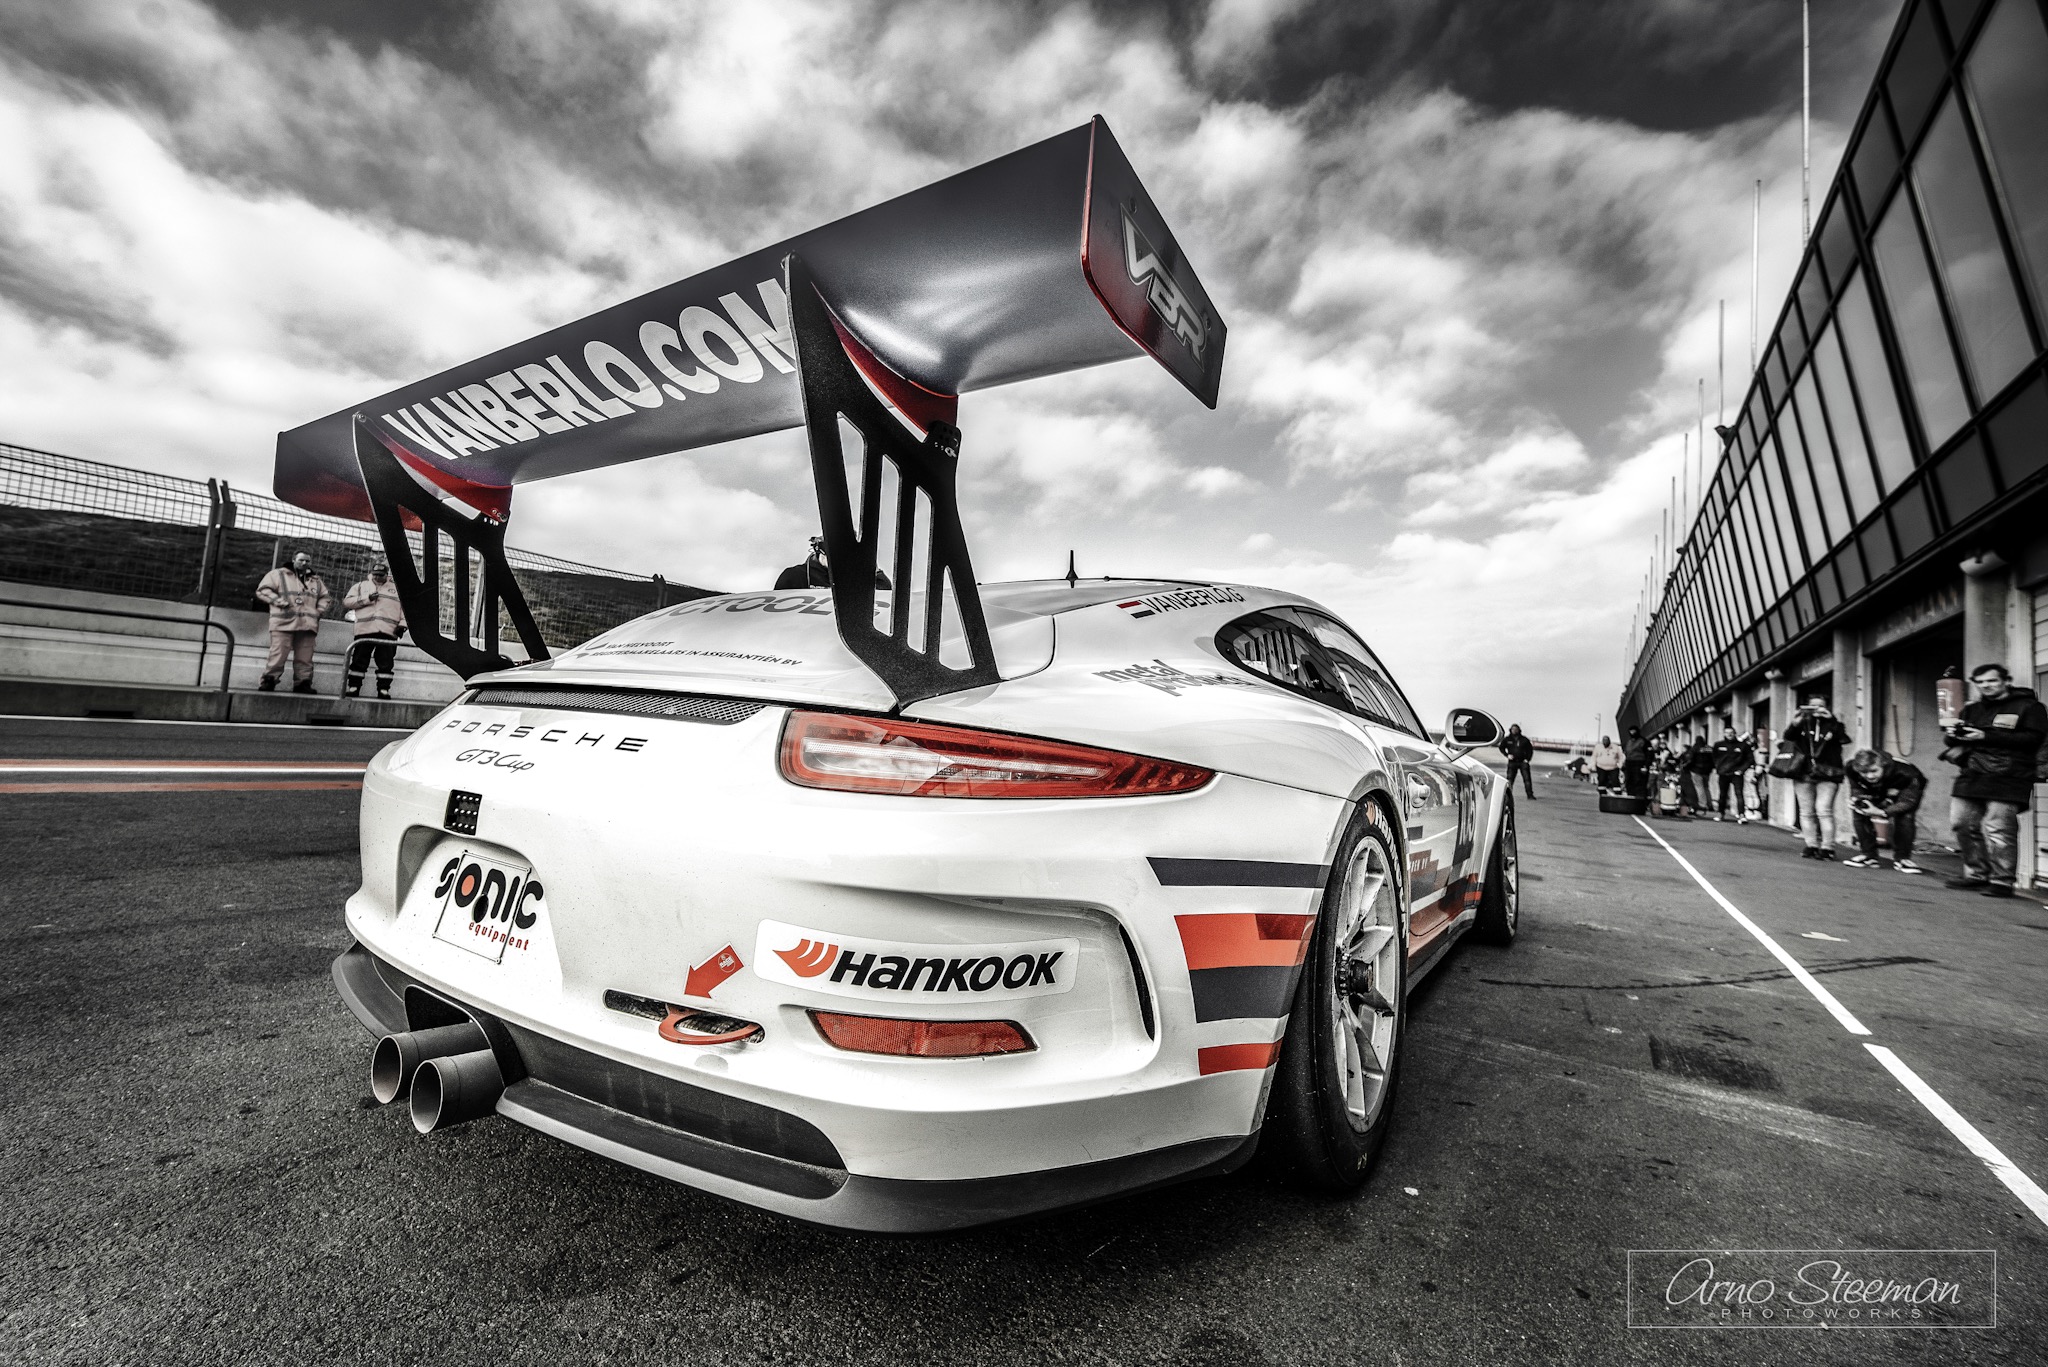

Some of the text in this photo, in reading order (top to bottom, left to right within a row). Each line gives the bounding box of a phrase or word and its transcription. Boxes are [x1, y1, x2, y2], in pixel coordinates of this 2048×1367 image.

[382, 278, 798, 460] VANBERLO.COM
[699, 650, 782, 664] ASSURANTIËN
[780, 658, 803, 667] BV
[442, 719, 649, 753] PORSCHE
[468, 921, 530, 951] equipment
